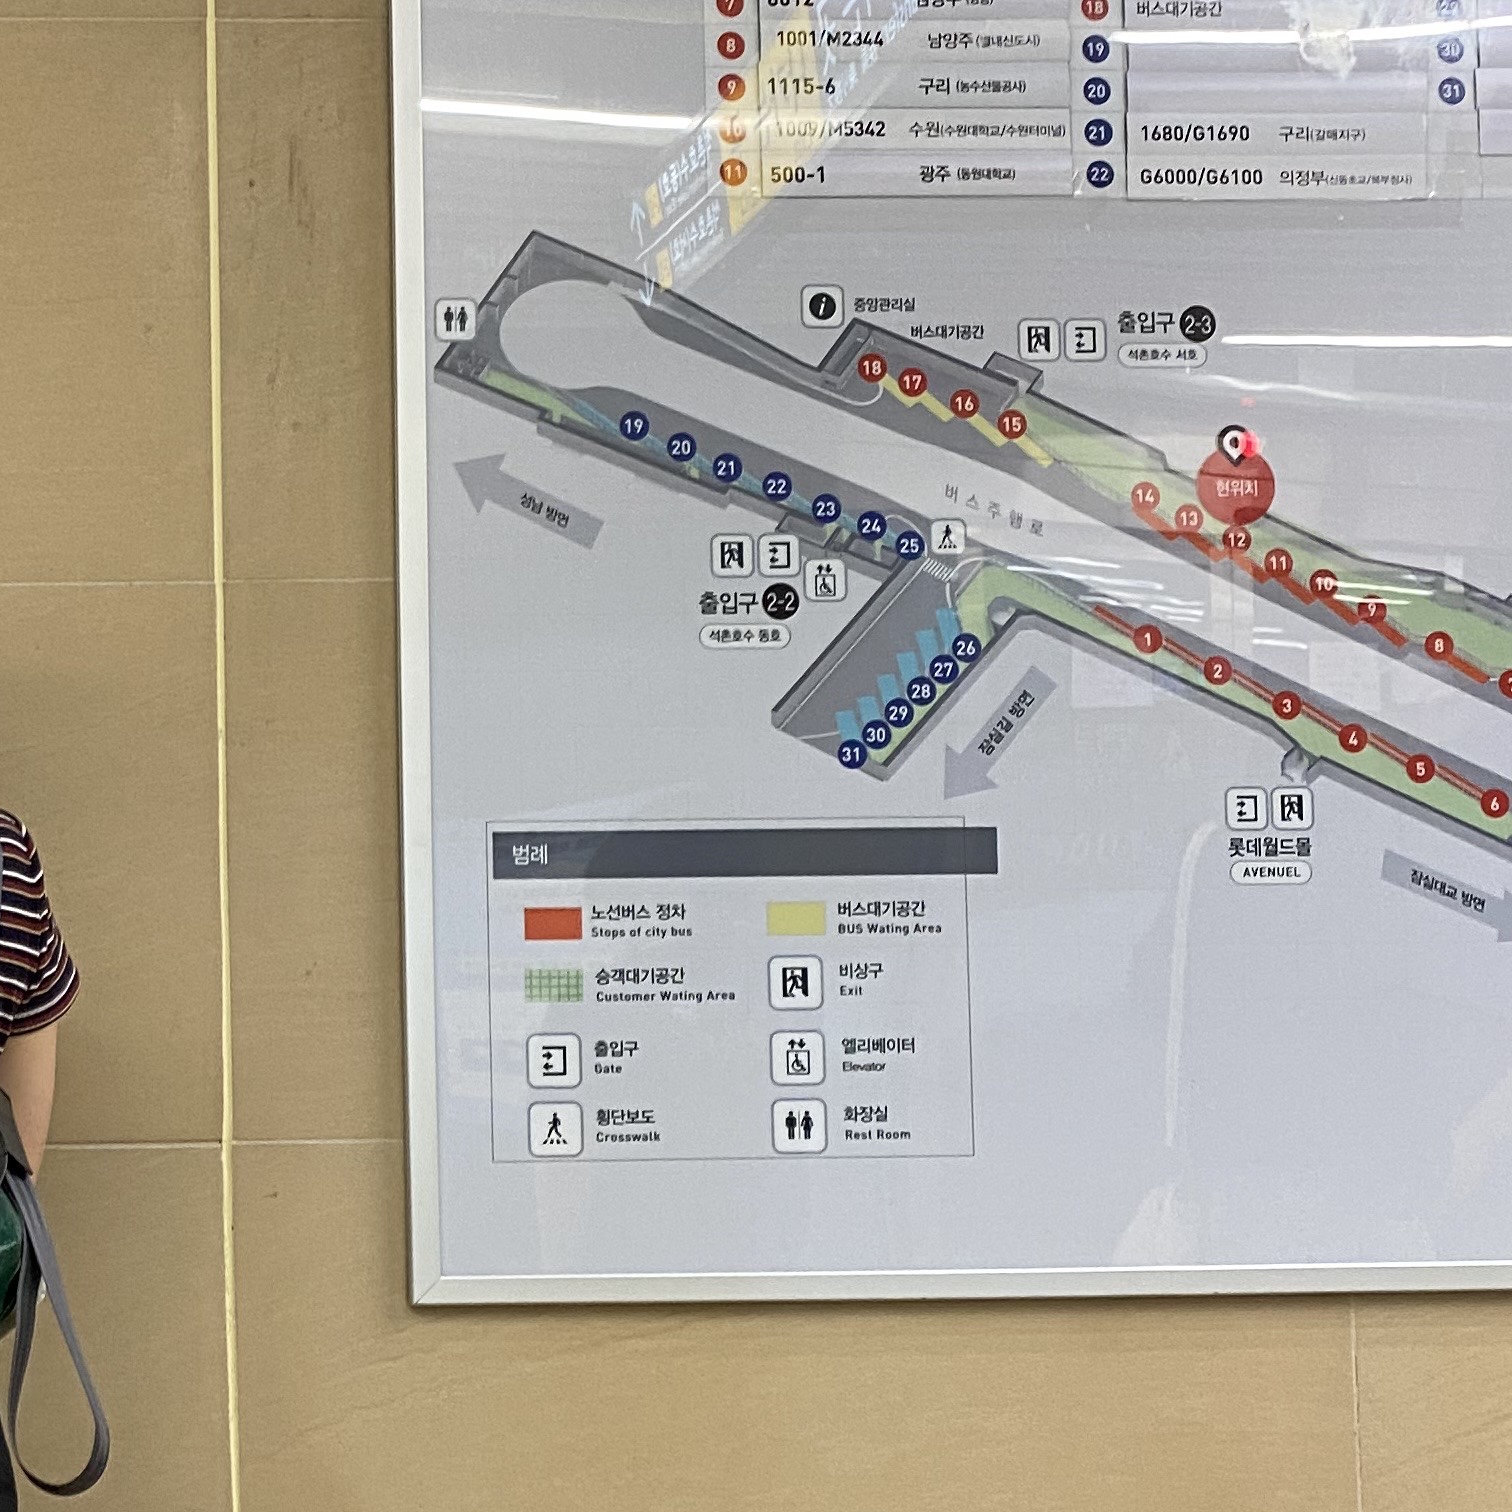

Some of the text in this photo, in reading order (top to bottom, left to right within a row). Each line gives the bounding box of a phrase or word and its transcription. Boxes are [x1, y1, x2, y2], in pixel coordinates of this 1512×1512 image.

[1137, 1, 1222, 17] 버스대기공간
[777, 30, 884, 47] 1001/M2344
[928, 32, 973, 49] 남양주
[768, 77, 836, 96] 1115-6
[918, 77, 950, 95] 구리
[1141, 124, 1250, 143] 1680/G1690
[771, 166, 825, 183] 500-1
[919, 164, 951, 182] 광주
[1140, 168, 1263, 186] G6000/G6100
[1118, 310, 1212, 334] 출입구 2-3
[911, 324, 984, 340] 버스대기공간
[1216, 479, 1258, 498] 현위치
[699, 591, 795, 614] 출입구 2-2
[512, 844, 548, 866] 범례
[1228, 837, 1312, 857] 롯데월드몰
[1242, 865, 1301, 878] AVENUEL
[591, 903, 686, 921] 노선버스 정차
[838, 901, 925, 917] 버스대기공간
[591, 926, 693, 940] Stops of city bus
[838, 923, 942, 937] BUS Wating Area
[595, 967, 685, 985] 승객대기공간
[839, 963, 883, 980] 비상구
[596, 990, 735, 1004] Customer Wating Area
[840, 985, 863, 996] Exit
[594, 1040, 639, 1057] 출입구
[841, 1037, 915, 1054] 엘리베이터
[594, 1063, 622, 1074] Gate
[842, 1060, 886, 1072] Elevator
[596, 1109, 656, 1126] 횡단보도
[843, 1105, 888, 1123] 화장실
[596, 1131, 660, 1143] Crosswalk
[845, 1129, 911, 1140] Rest Room
